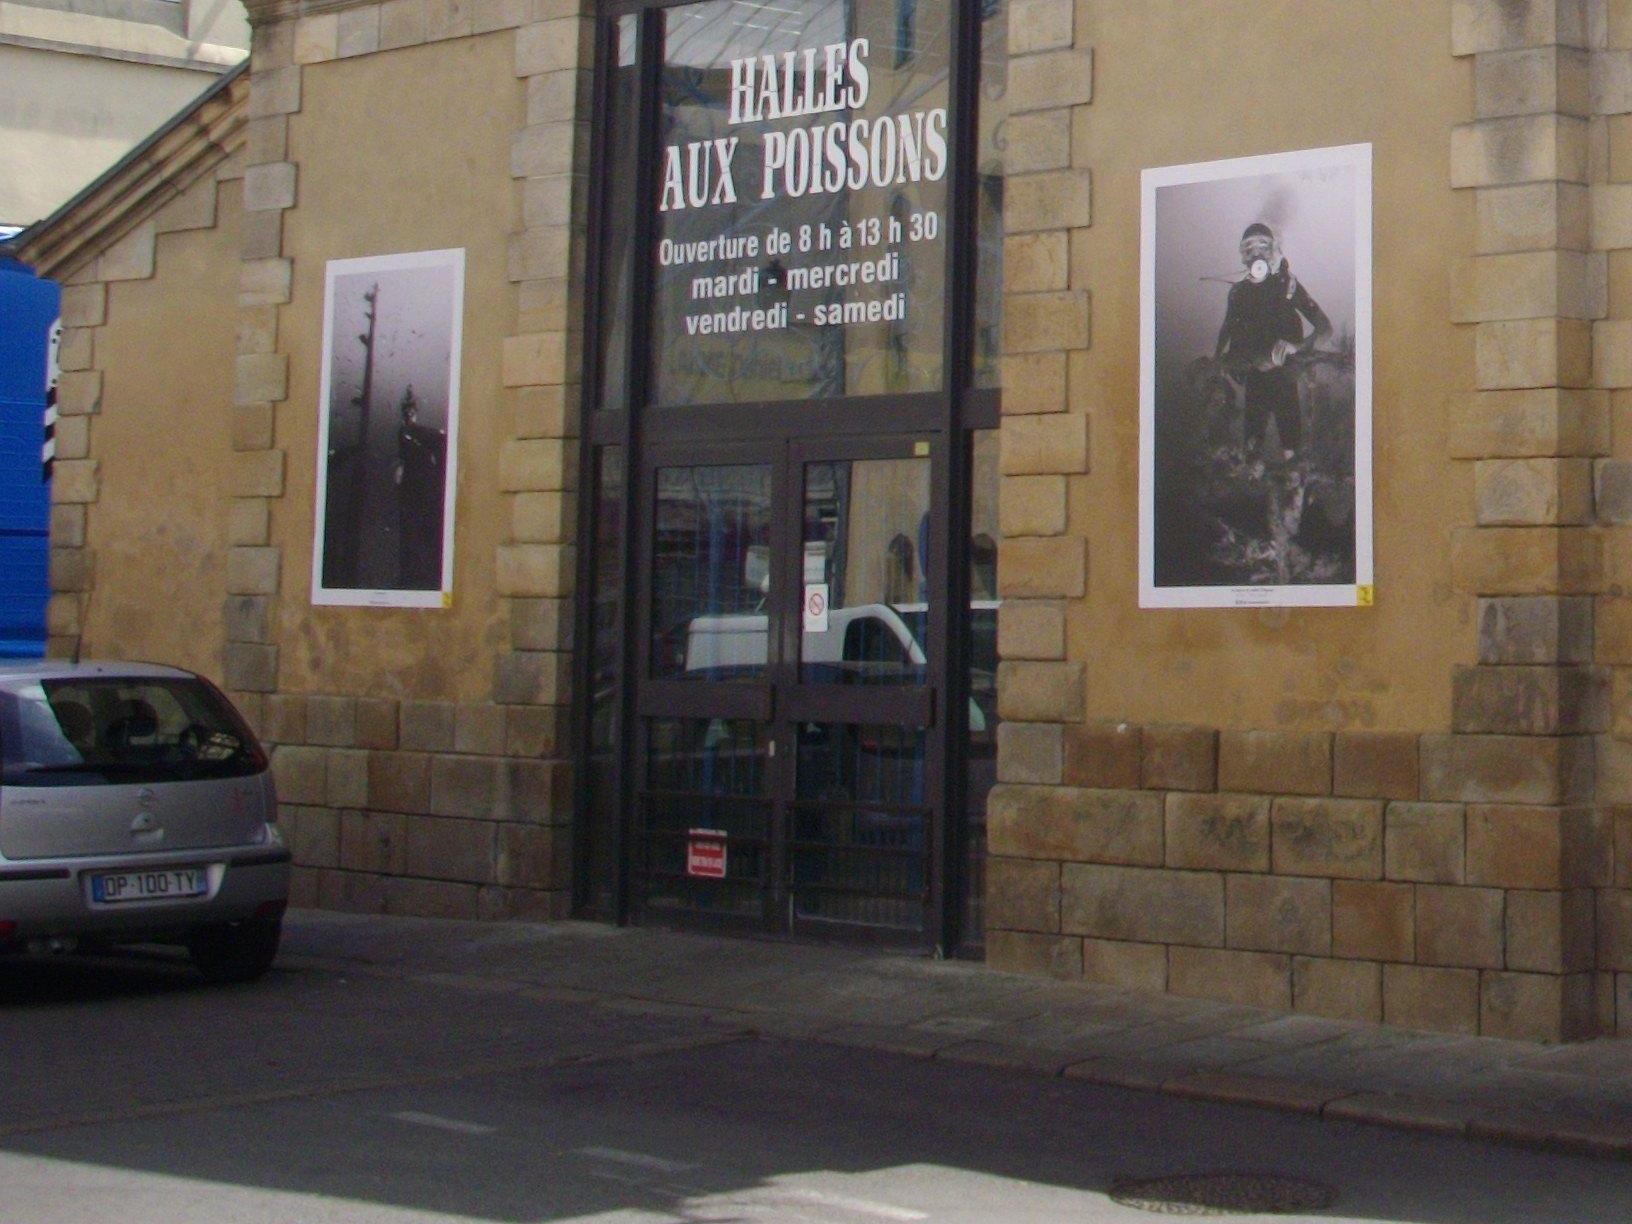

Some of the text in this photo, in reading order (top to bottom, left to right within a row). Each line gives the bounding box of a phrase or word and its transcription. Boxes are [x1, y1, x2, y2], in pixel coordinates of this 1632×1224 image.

[728, 38, 869, 124] HALLES
[659, 108, 947, 211] AUX POISSONS
[660, 212, 937, 266] Ouverture de 8 h à 13 h 30
[692, 267, 759, 299] mardi
[787, 253, 899, 291] mercredi
[686, 301, 787, 335] vendredi
[814, 293, 905, 326] samedi
